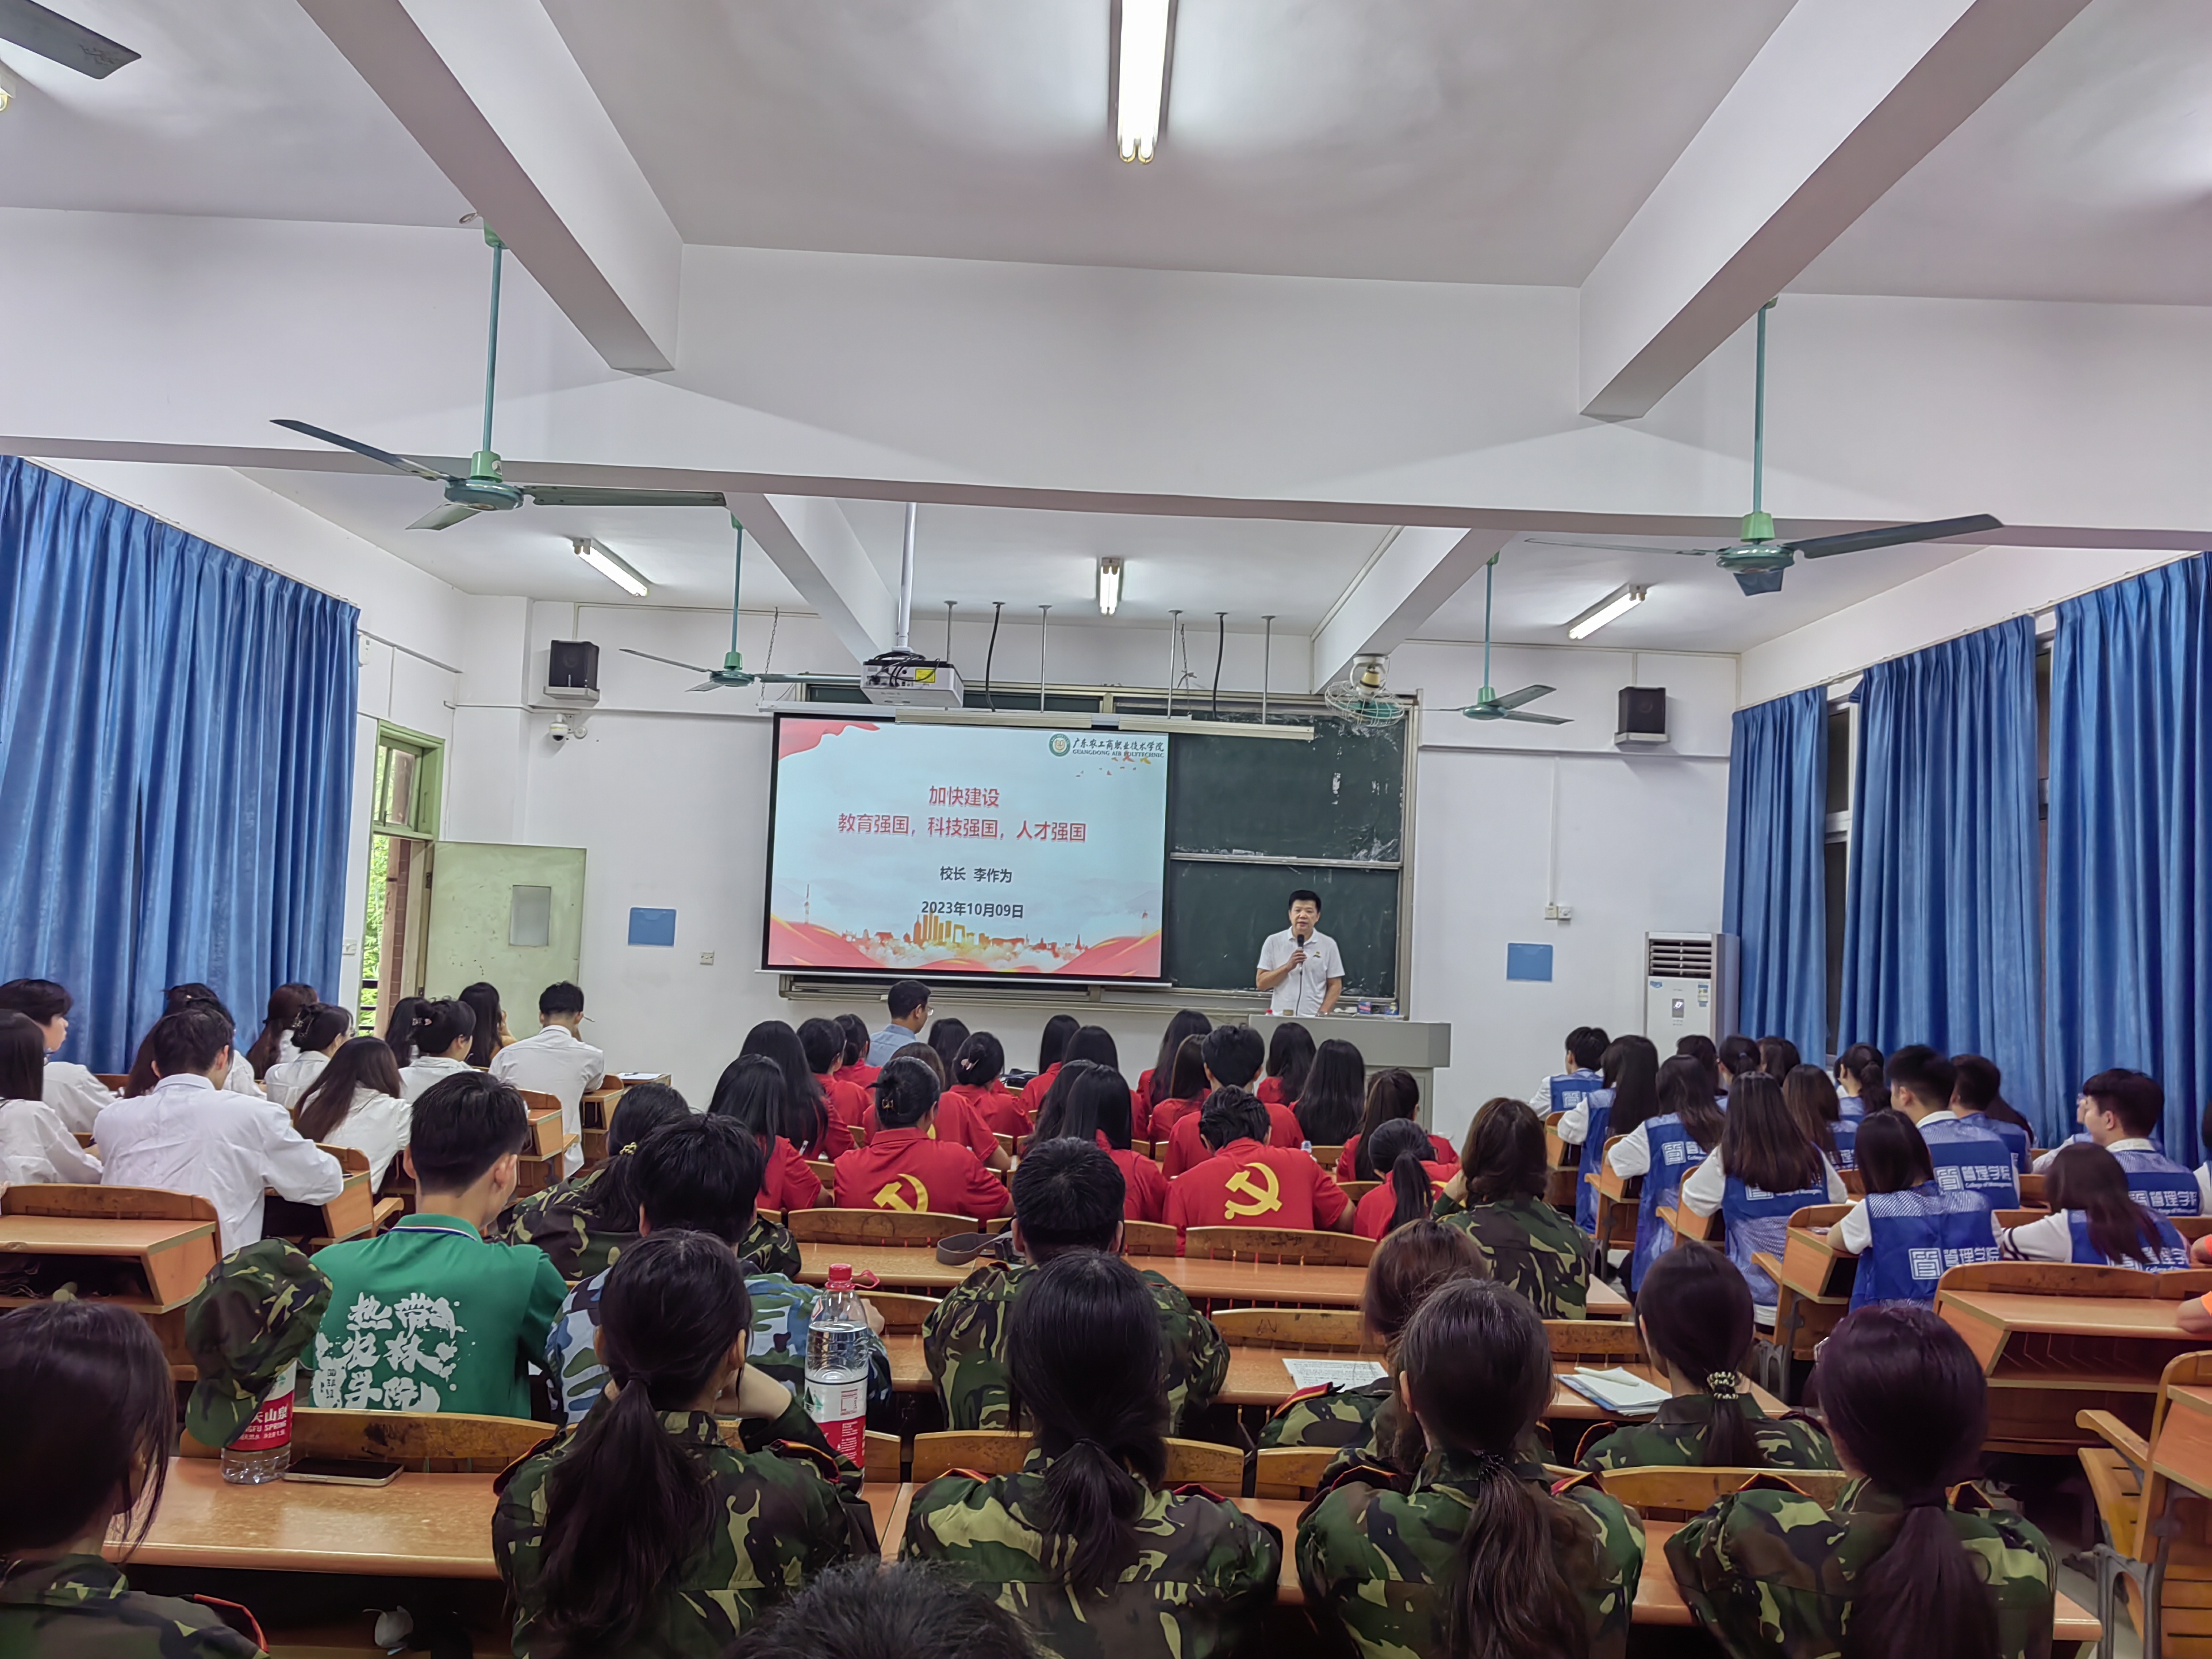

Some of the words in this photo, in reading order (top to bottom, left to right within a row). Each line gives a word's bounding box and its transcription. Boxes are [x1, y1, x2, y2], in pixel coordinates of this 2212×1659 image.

[928, 785, 1000, 807] 加快建设
[940, 866, 967, 881] 校长
[973, 867, 1013, 883] 李作为
[921, 901, 1024, 919] 2023年10月09日
